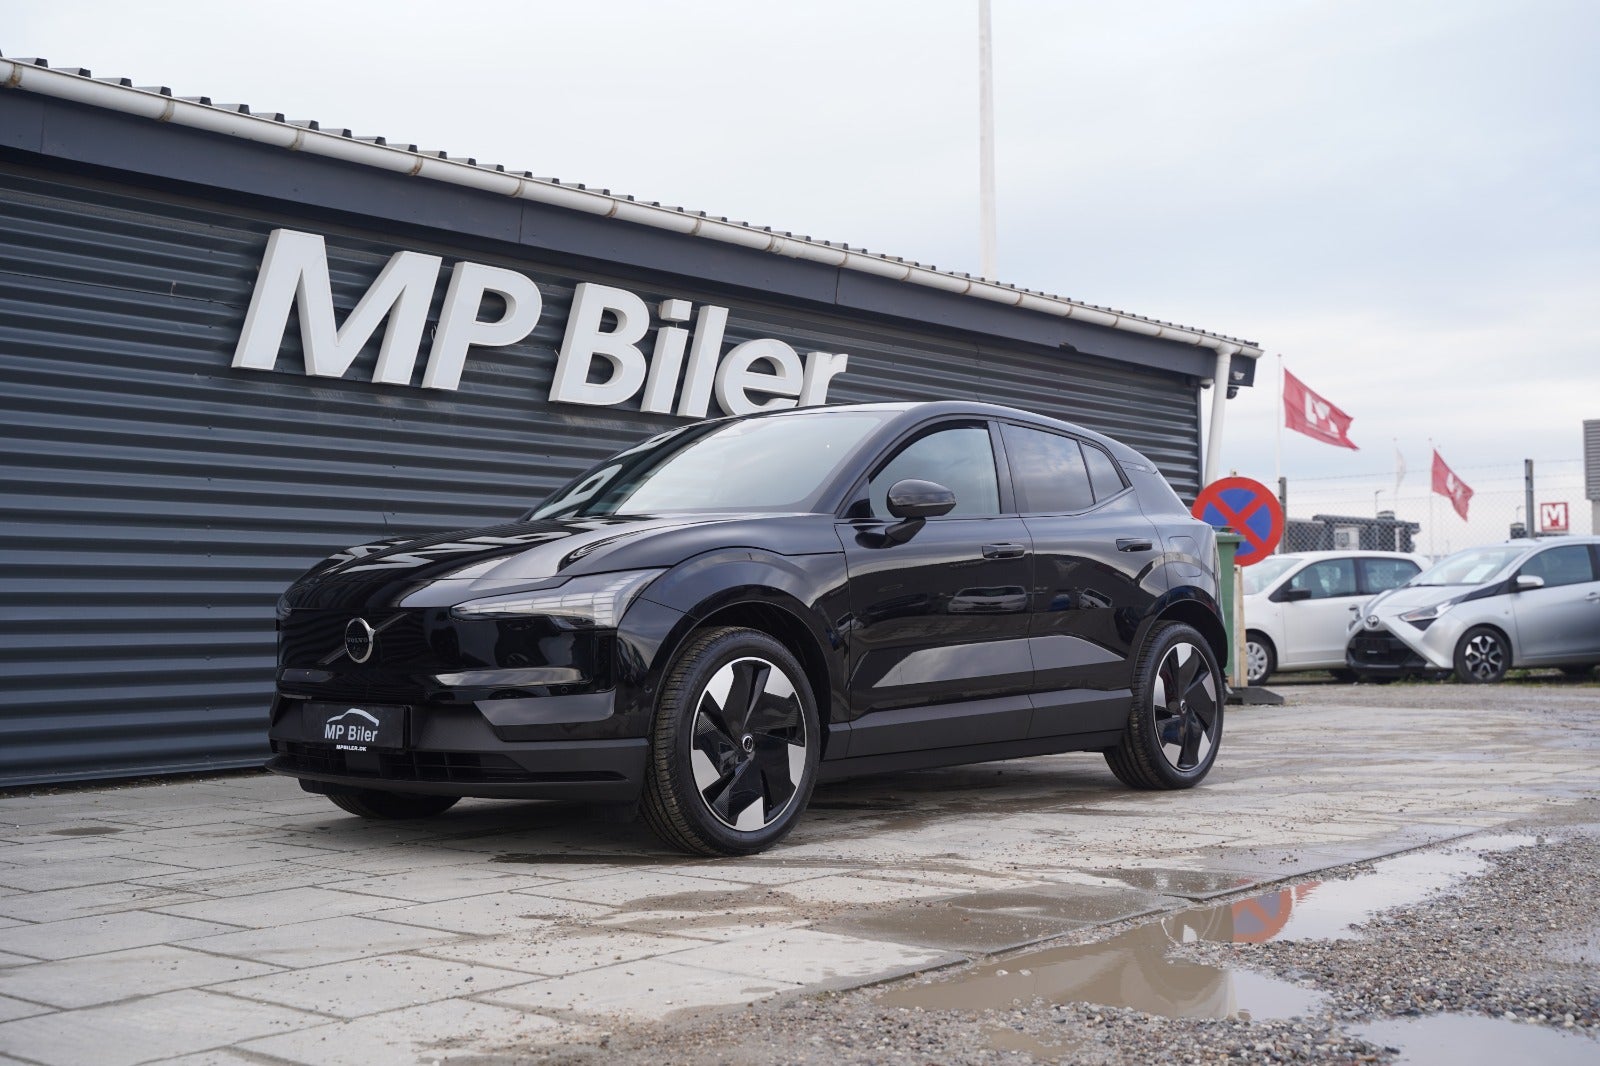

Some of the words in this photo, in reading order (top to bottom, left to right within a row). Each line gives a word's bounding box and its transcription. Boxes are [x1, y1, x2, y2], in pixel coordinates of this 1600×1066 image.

[232, 228, 542, 391] MP
[549, 282, 848, 418] Biler
[324, 724, 345, 740] MP
[347, 725, 378, 742] Biler
